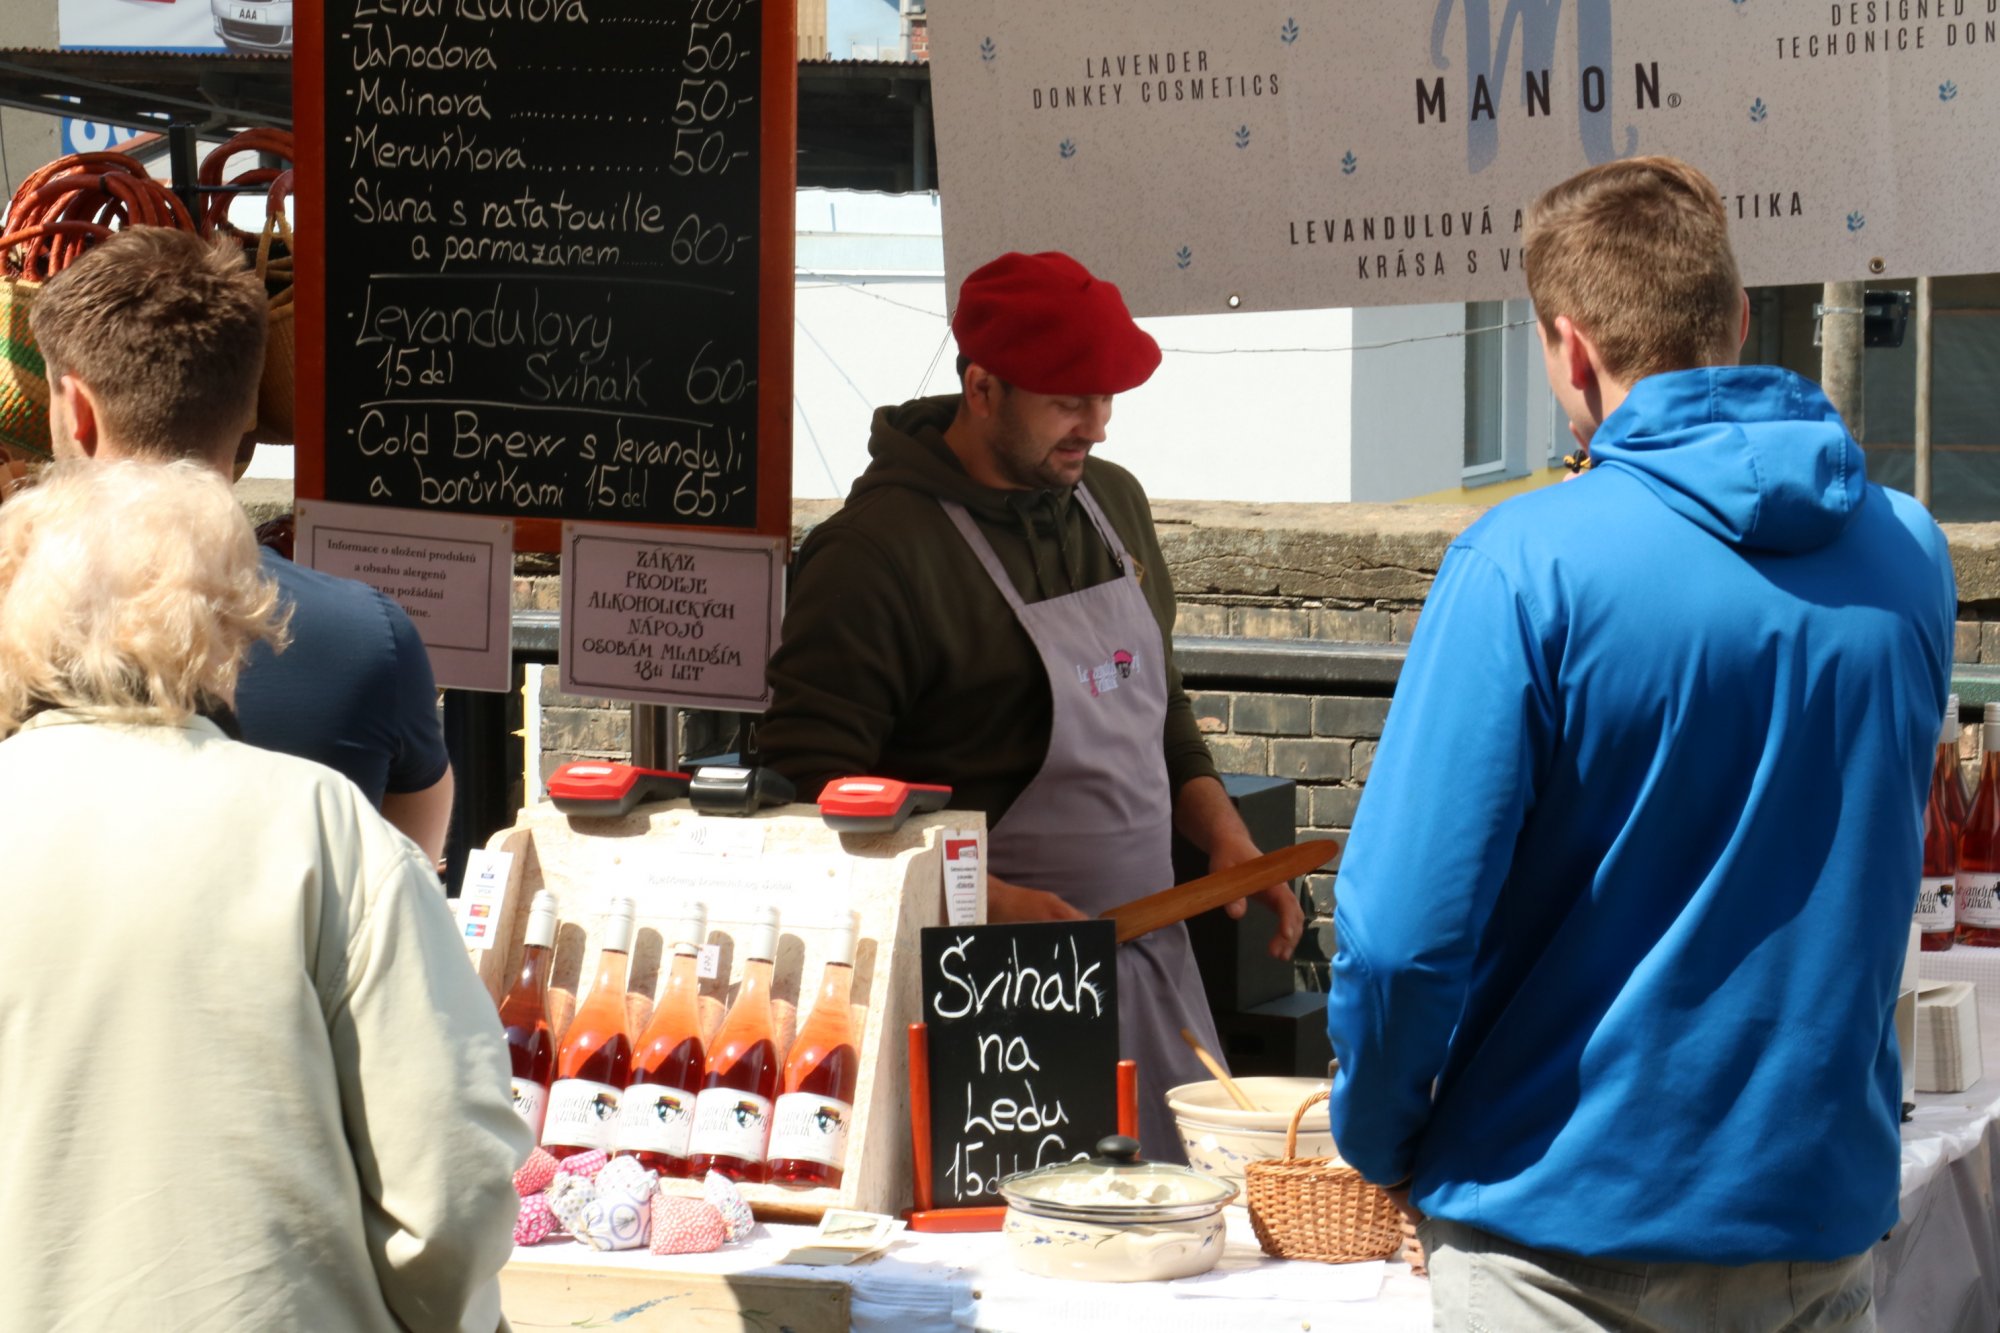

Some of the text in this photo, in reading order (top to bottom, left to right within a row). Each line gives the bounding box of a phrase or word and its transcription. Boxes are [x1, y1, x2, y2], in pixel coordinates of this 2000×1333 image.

[239, 8, 257, 20] AAA
[1832, 0, 1964, 26] DESIGNED
[352, 22, 751, 73] Jahodová 50,-
[1776, 26, 1924, 59] TECHONICE
[1086, 50, 1209, 78] LAVENDER
[355, 78, 754, 126] Malinová 50,-
[1032, 73, 1281, 110] DONKEY COSMETICS
[1416, 61, 1660, 124] MANON
[350, 123, 750, 176] Meruňková 50,-
[354, 177, 666, 235] Slaná s ratatouille
[1289, 206, 1493, 245] LEVANDULOVÁ
[1722, 191, 1802, 219] TIKA
[412, 235, 430, 260] a
[440, 234, 621, 273] parmazánem
[1357, 250, 1445, 279] KRÁSA
[1467, 249, 1478, 274] S
[356, 282, 613, 364] Levandulový
[519, 349, 653, 407] Švihák
[358, 410, 746, 473] Cold Brew s levanduli
[370, 475, 392, 497] a
[412, 457, 569, 508] borůvkami
[327, 539, 477, 565] Informace o složení produktů
[636, 547, 695, 573] ZÁKAZ
[354, 561, 447, 581] a obsahu alergenů
[625, 570, 708, 595] PRODEJE
[382, 585, 395, 595] na
[588, 590, 735, 620] ALKOHOLICKÝCH
[627, 616, 704, 640] NÁPOJŮ
[582, 638, 742, 667] OSOBÁM MLADŠÍM
[672, 664, 705, 681] LET
[933, 935, 1106, 1020] Švihák
[978, 1032, 1040, 1074] na
[964, 1080, 1069, 1135] Ledu
